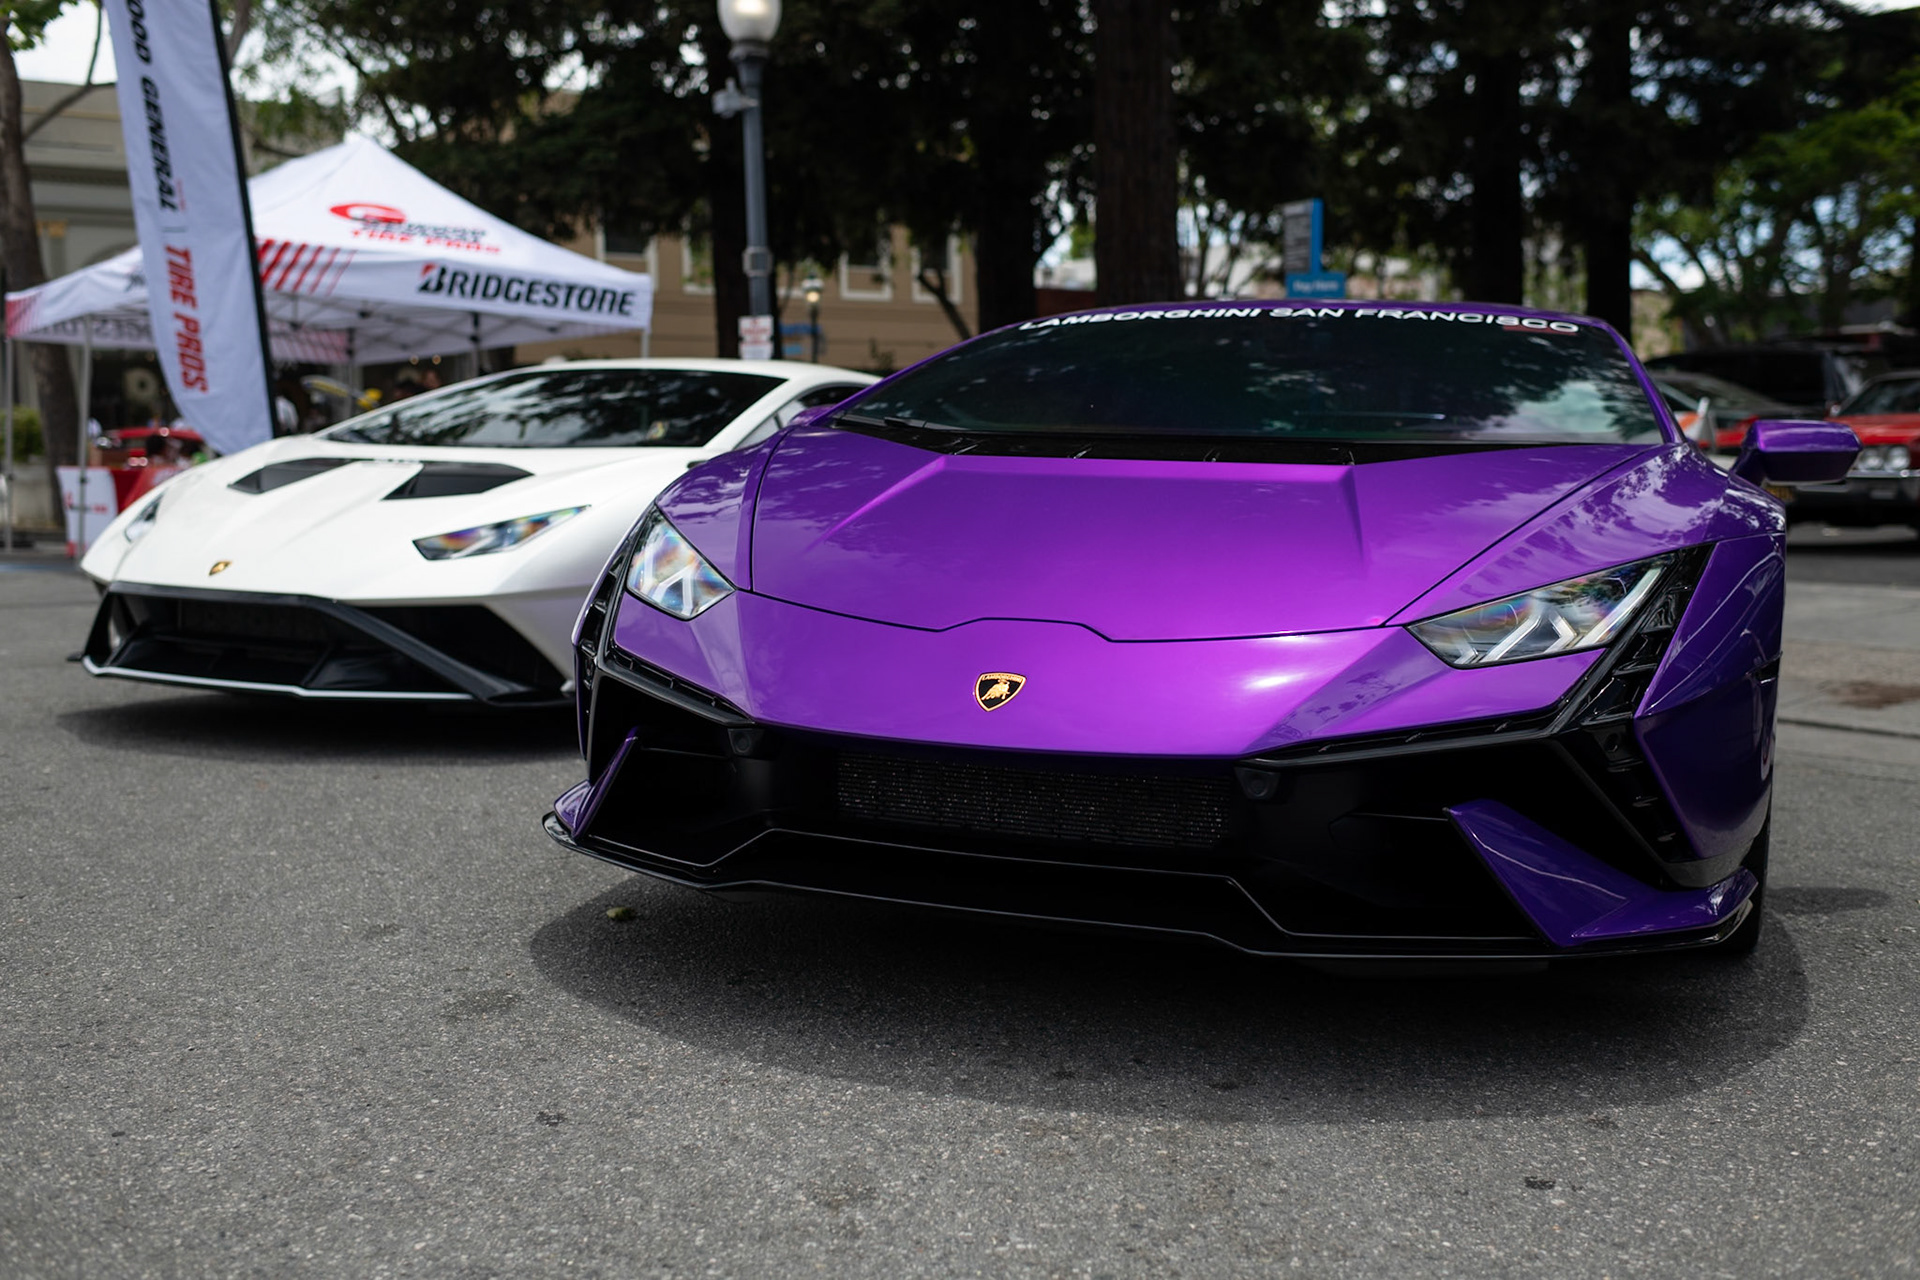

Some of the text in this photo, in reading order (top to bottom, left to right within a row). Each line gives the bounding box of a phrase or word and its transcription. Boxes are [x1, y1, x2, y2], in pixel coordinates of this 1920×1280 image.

[126, 0, 208, 392] OOD GENERAL TIRE PROS
[418, 263, 636, 315] BRIDGESTONE
[1019, 308, 1579, 333] LAMBORGHINI SAN FRANCISCO
